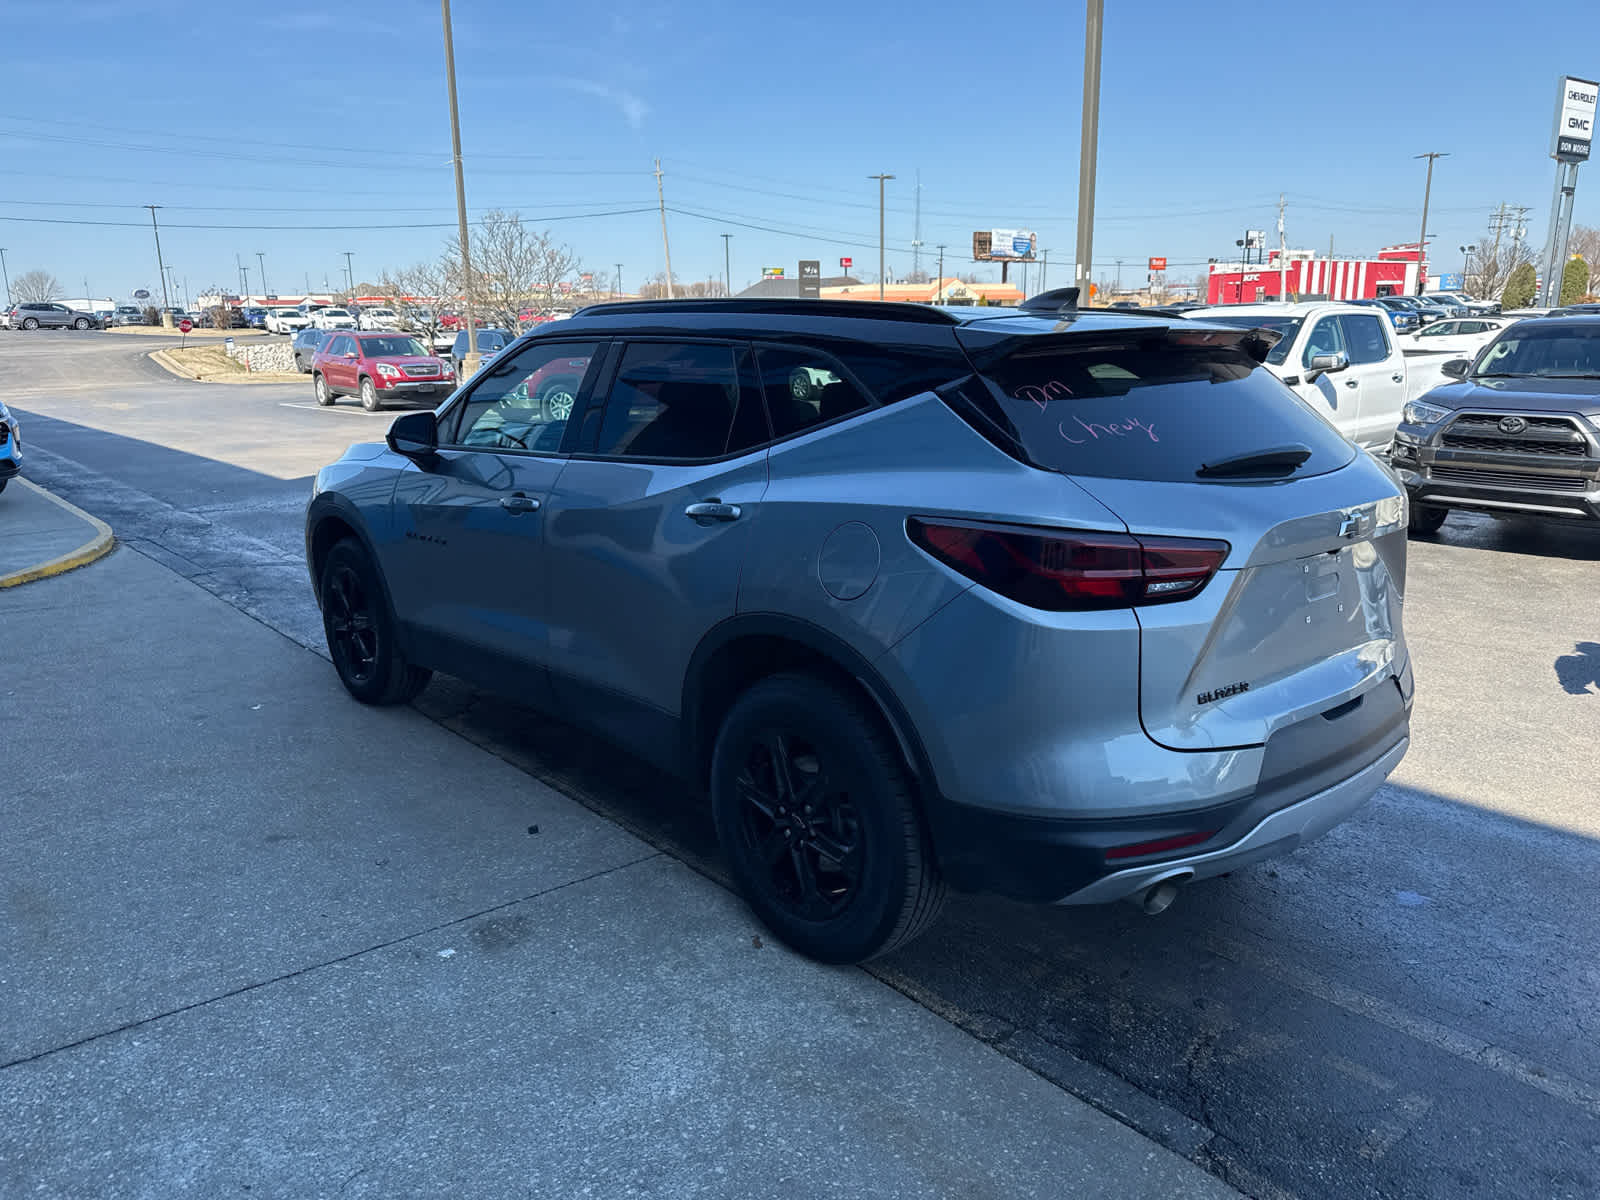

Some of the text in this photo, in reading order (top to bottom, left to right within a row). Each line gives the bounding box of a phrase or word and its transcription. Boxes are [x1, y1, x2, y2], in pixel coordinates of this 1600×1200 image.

[1568, 90, 1596, 104] CHEVROLET
[1568, 117, 1589, 131] GMC
[1560, 142, 1572, 152] DON
[1243, 274, 1260, 282] KFC
[1058, 415, 1160, 444] Chevy
[1196, 681, 1249, 705] BLAZER
